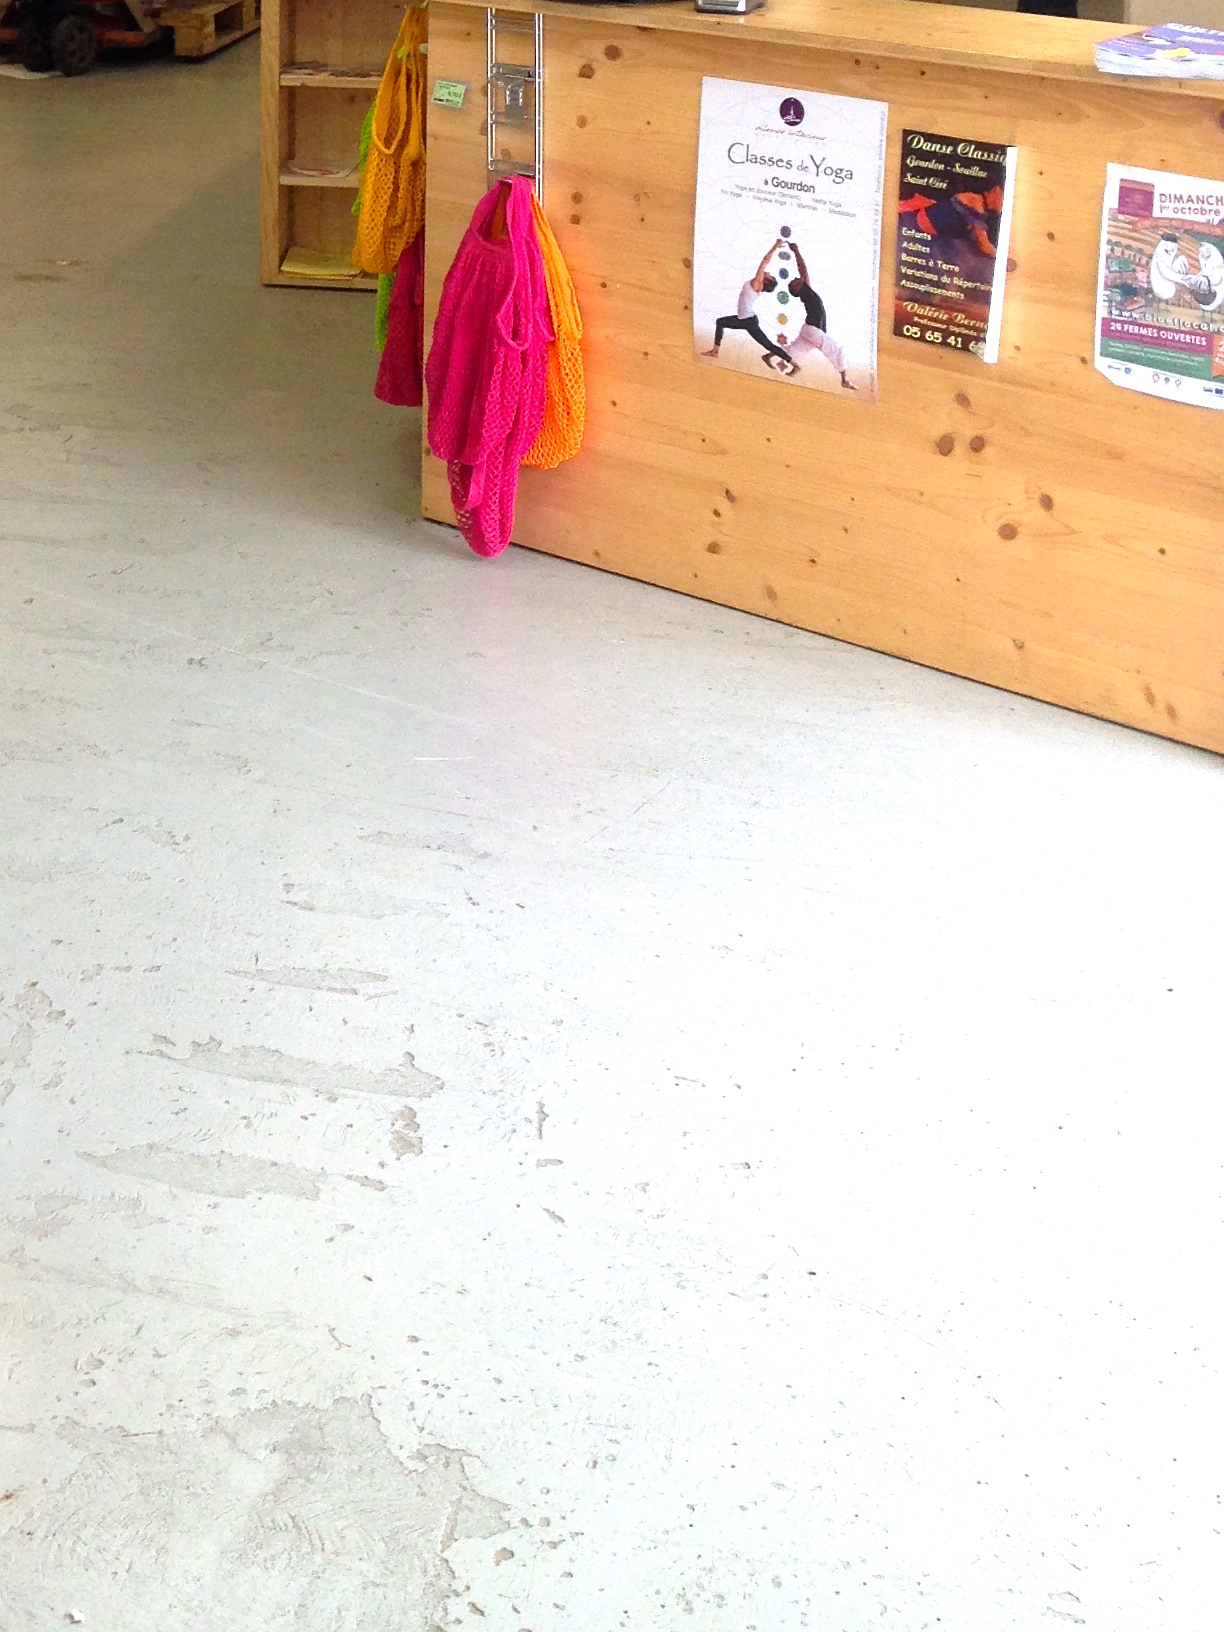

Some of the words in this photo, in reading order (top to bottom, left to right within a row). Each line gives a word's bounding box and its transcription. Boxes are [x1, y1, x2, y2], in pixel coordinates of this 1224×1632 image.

[907, 134, 954, 155] Danse
[727, 142, 793, 169] Classes
[796, 160, 809, 173] de
[809, 154, 854, 184] Yoga
[906, 155, 945, 170] Gourdon
[763, 178, 769, 186] à
[771, 177, 816, 194] Gourdon
[904, 173, 928, 185] Saint
[1173, 206, 1221, 216] octobre
[902, 228, 931, 240] Enfants
[902, 241, 930, 254] Adultes
[901, 253, 926, 266] Barres
[937, 260, 959, 272] Terre
[901, 266, 938, 281] Variations
[941, 275, 951, 284] du
[900, 279, 964, 299] Assouplissements
[903, 301, 949, 320] Valérie
[903, 325, 921, 338] 05
[925, 331, 942, 343] 65
[947, 336, 962, 348] 41
[1123, 324, 1158, 337] FERMES
[1160, 330, 1207, 346] OUVERTES
